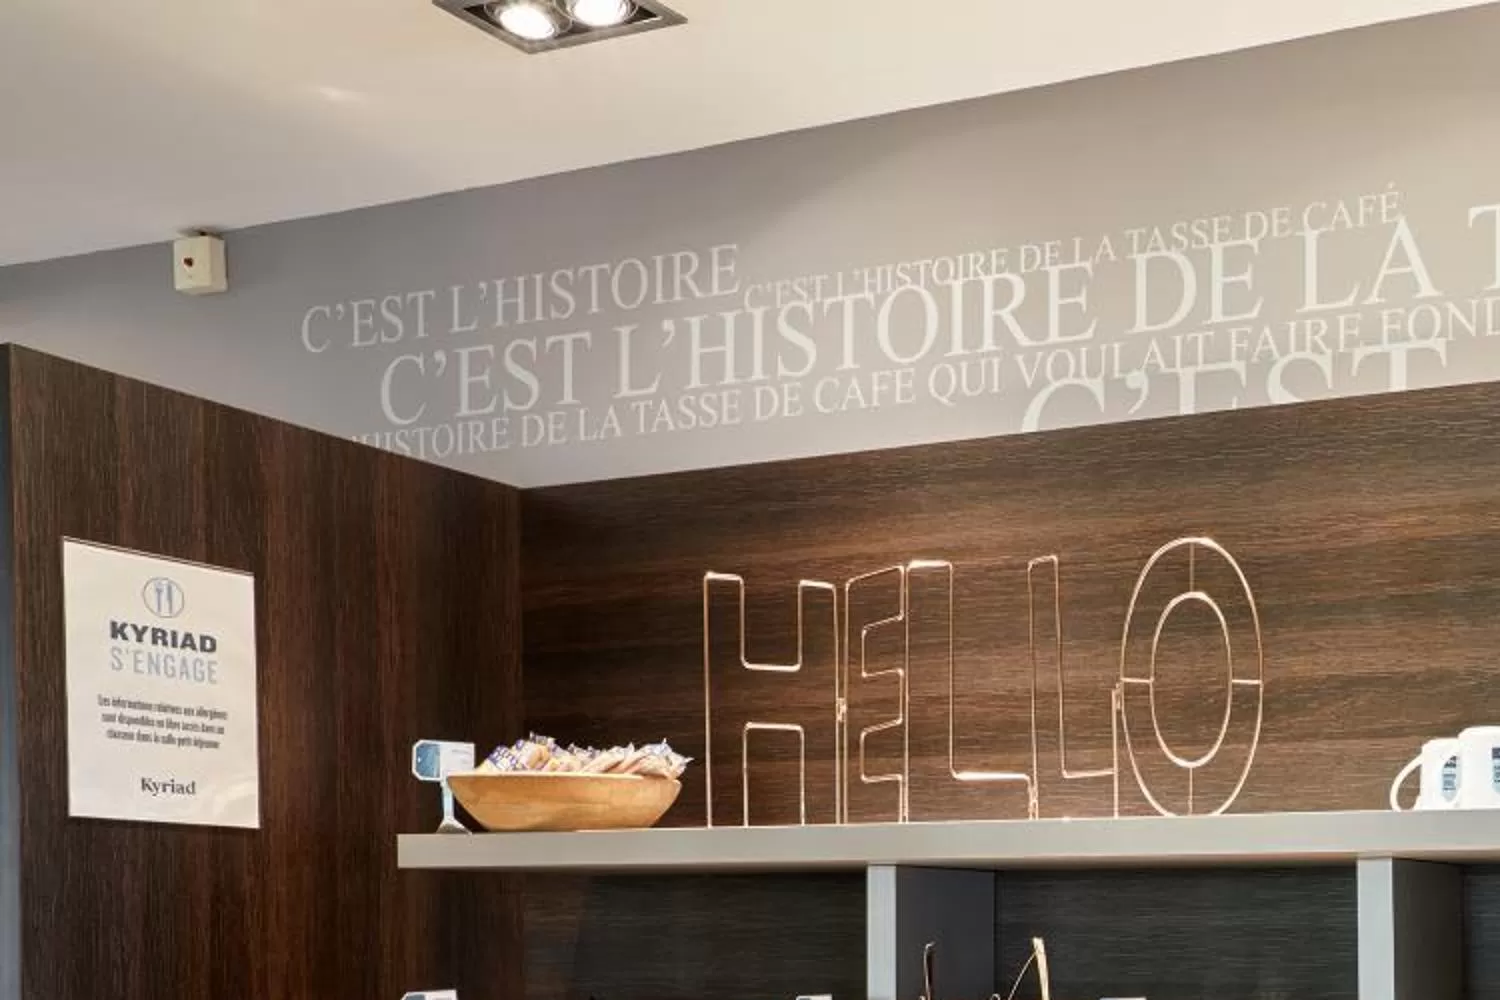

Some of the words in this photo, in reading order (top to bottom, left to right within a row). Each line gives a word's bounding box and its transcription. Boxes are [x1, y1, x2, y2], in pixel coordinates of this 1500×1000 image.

[1020, 240, 1060, 273] DE
[1072, 234, 1118, 268] LA
[1124, 214, 1232, 258] TASSE
[1244, 206, 1292, 242] DE
[1302, 181, 1402, 232] CAFÉ
[302, 289, 434, 353] C'EST
[449, 244, 740, 335] L'HISTOIRE
[381, 331, 592, 426] C'EST
[613, 258, 1098, 400] L'HISTOIRE
[1126, 238, 1264, 335] DE
[1296, 216, 1442, 315] LA
[521, 411, 569, 448] DE
[579, 405, 623, 442] LA
[631, 389, 741, 435] TASSE
[754, 382, 802, 423] DE
[815, 368, 917, 414] CAFE
[928, 355, 1002, 404] QUI
[1015, 331, 1215, 390] VOULAIT
[1229, 311, 1364, 365] FAIRE
[109, 620, 218, 653] KYRIAD
[110, 645, 219, 685] S'ENGAGE
[704, 536, 1263, 828] HELLO
[141, 777, 196, 797] Kyriad
